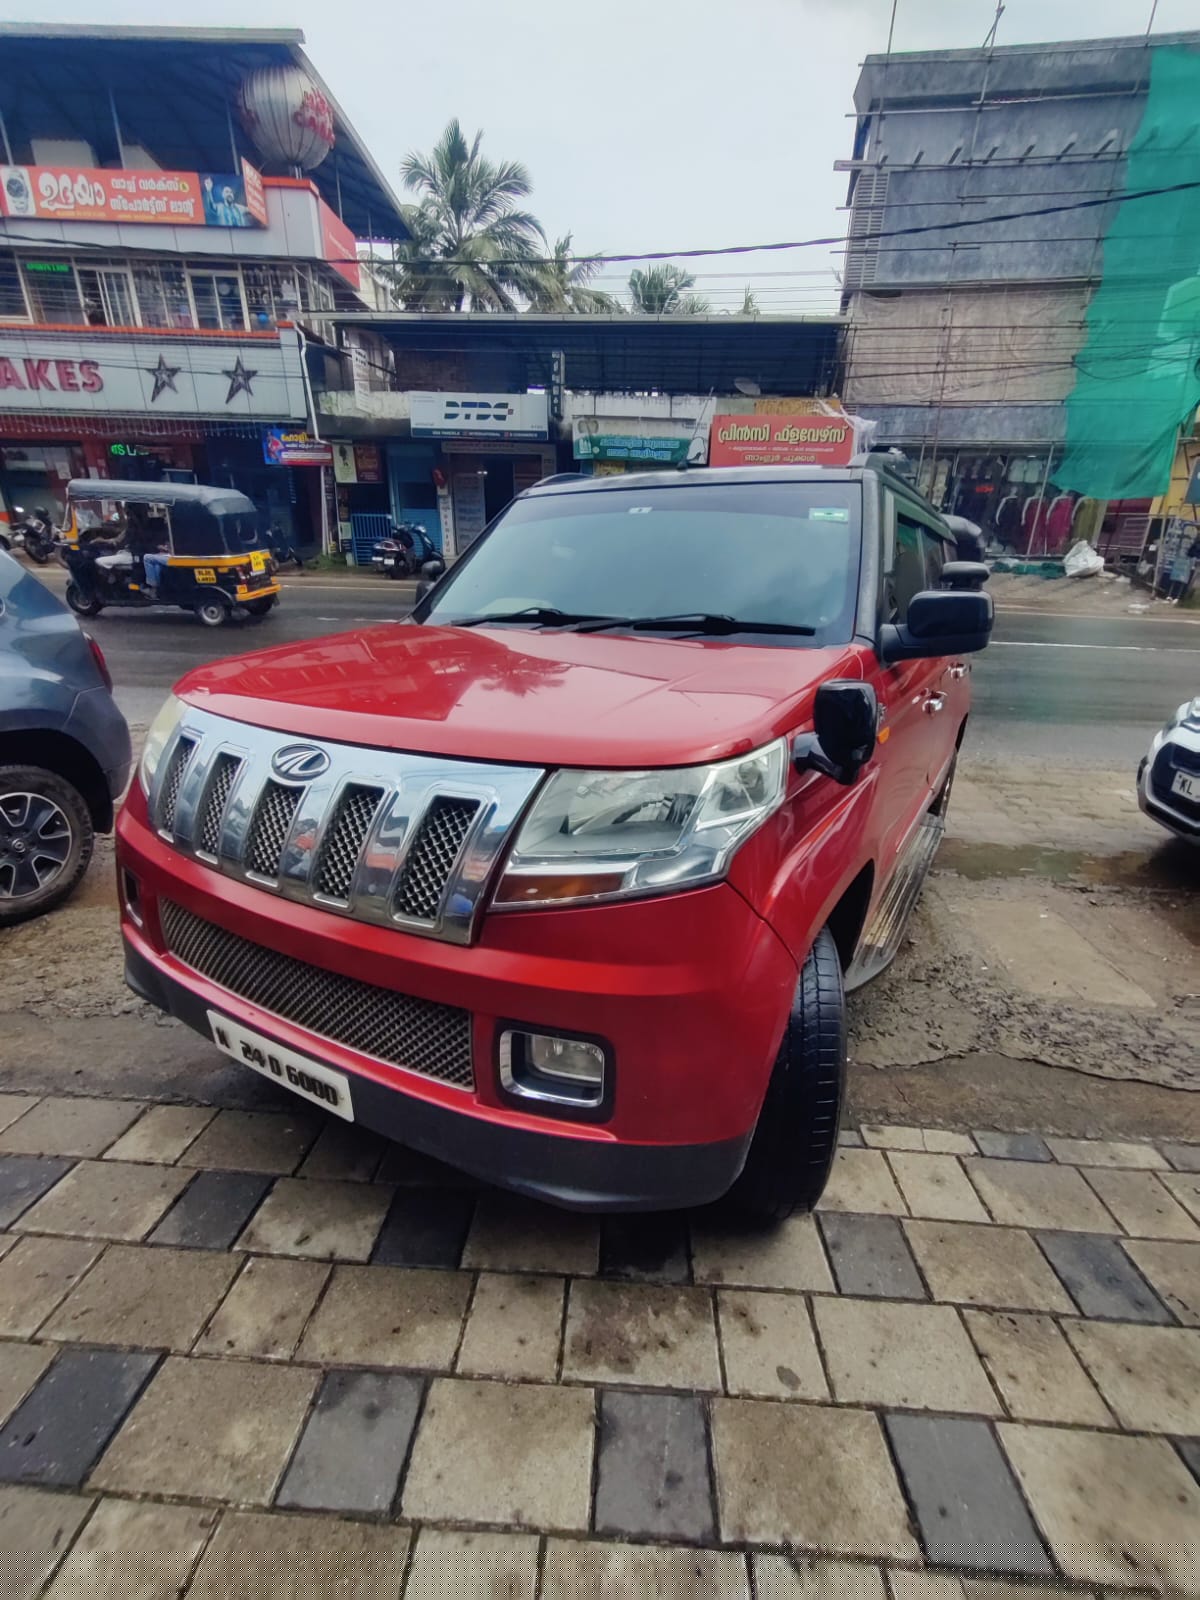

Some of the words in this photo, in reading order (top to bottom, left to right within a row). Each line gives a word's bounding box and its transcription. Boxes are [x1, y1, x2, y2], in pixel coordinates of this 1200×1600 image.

[38, 172, 106, 211] ഉദയാ
[444, 401, 509, 421] DTDC
[717, 422, 770, 443] പ്രിൻസി
[1180, 777, 1193, 795] KL
[240, 1040, 265, 1068] 24
[286, 1065, 338, 1106] 6000
